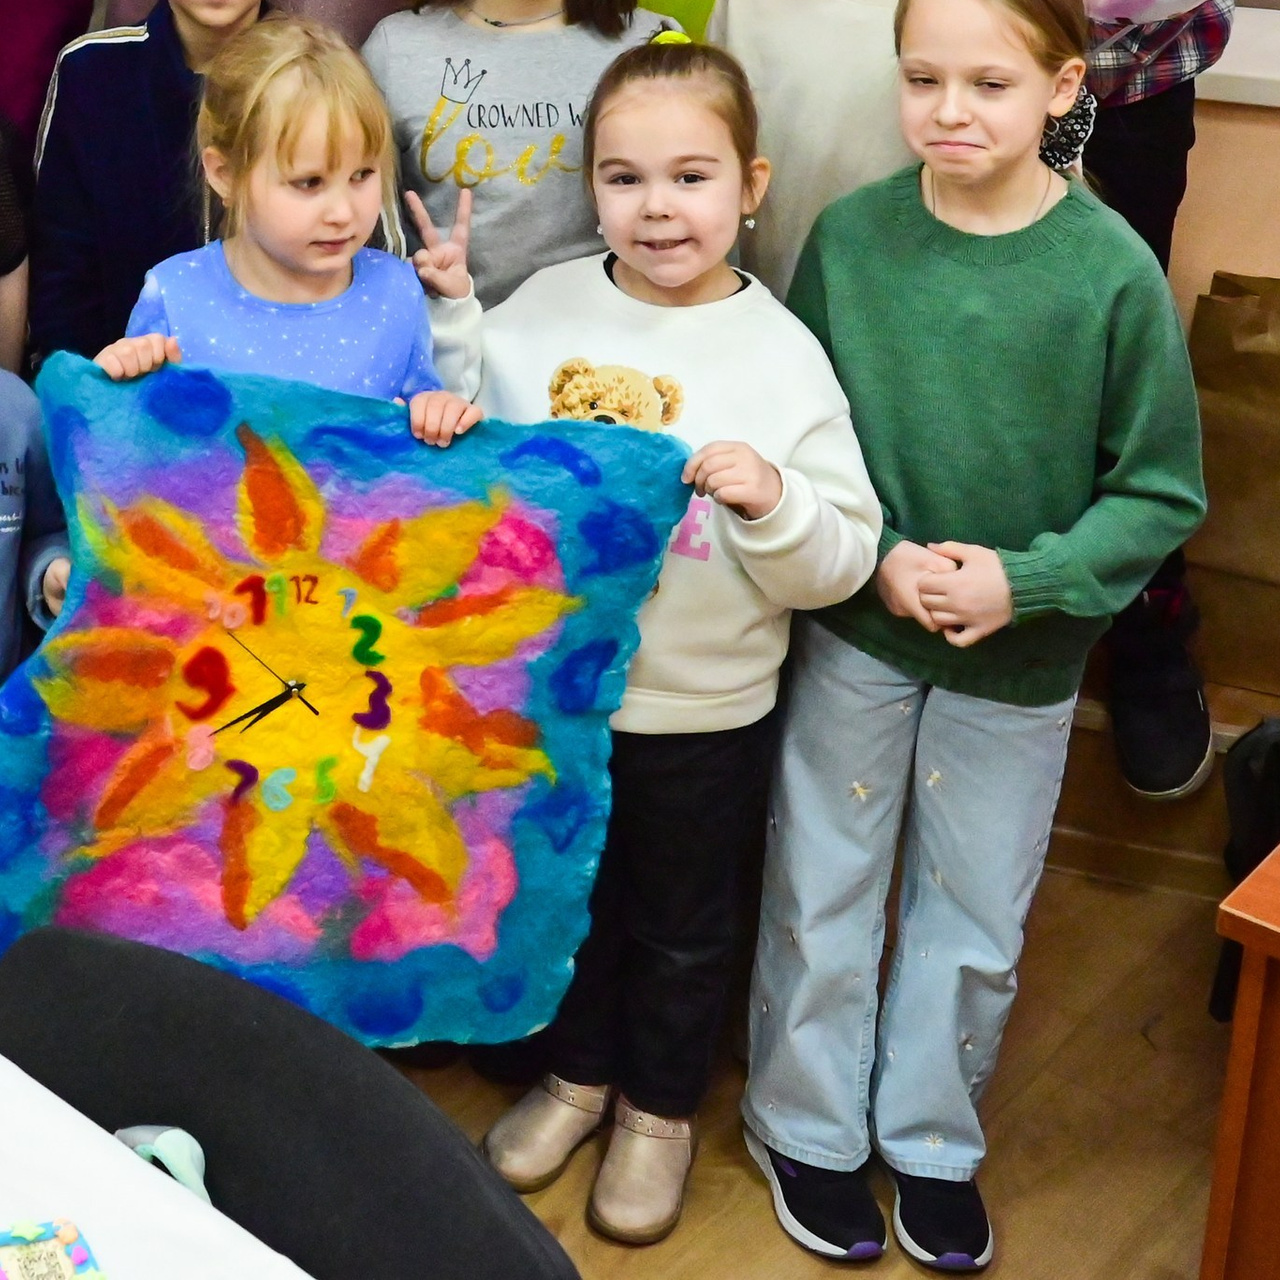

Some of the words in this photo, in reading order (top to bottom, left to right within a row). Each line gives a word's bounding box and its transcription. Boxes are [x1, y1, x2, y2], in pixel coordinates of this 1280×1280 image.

[467, 102, 559, 128] CROWNED
[289, 574, 319, 605] 12
[350, 614, 386, 666] 2
[175, 646, 237, 721] 9
[352, 670, 393, 731] 3
